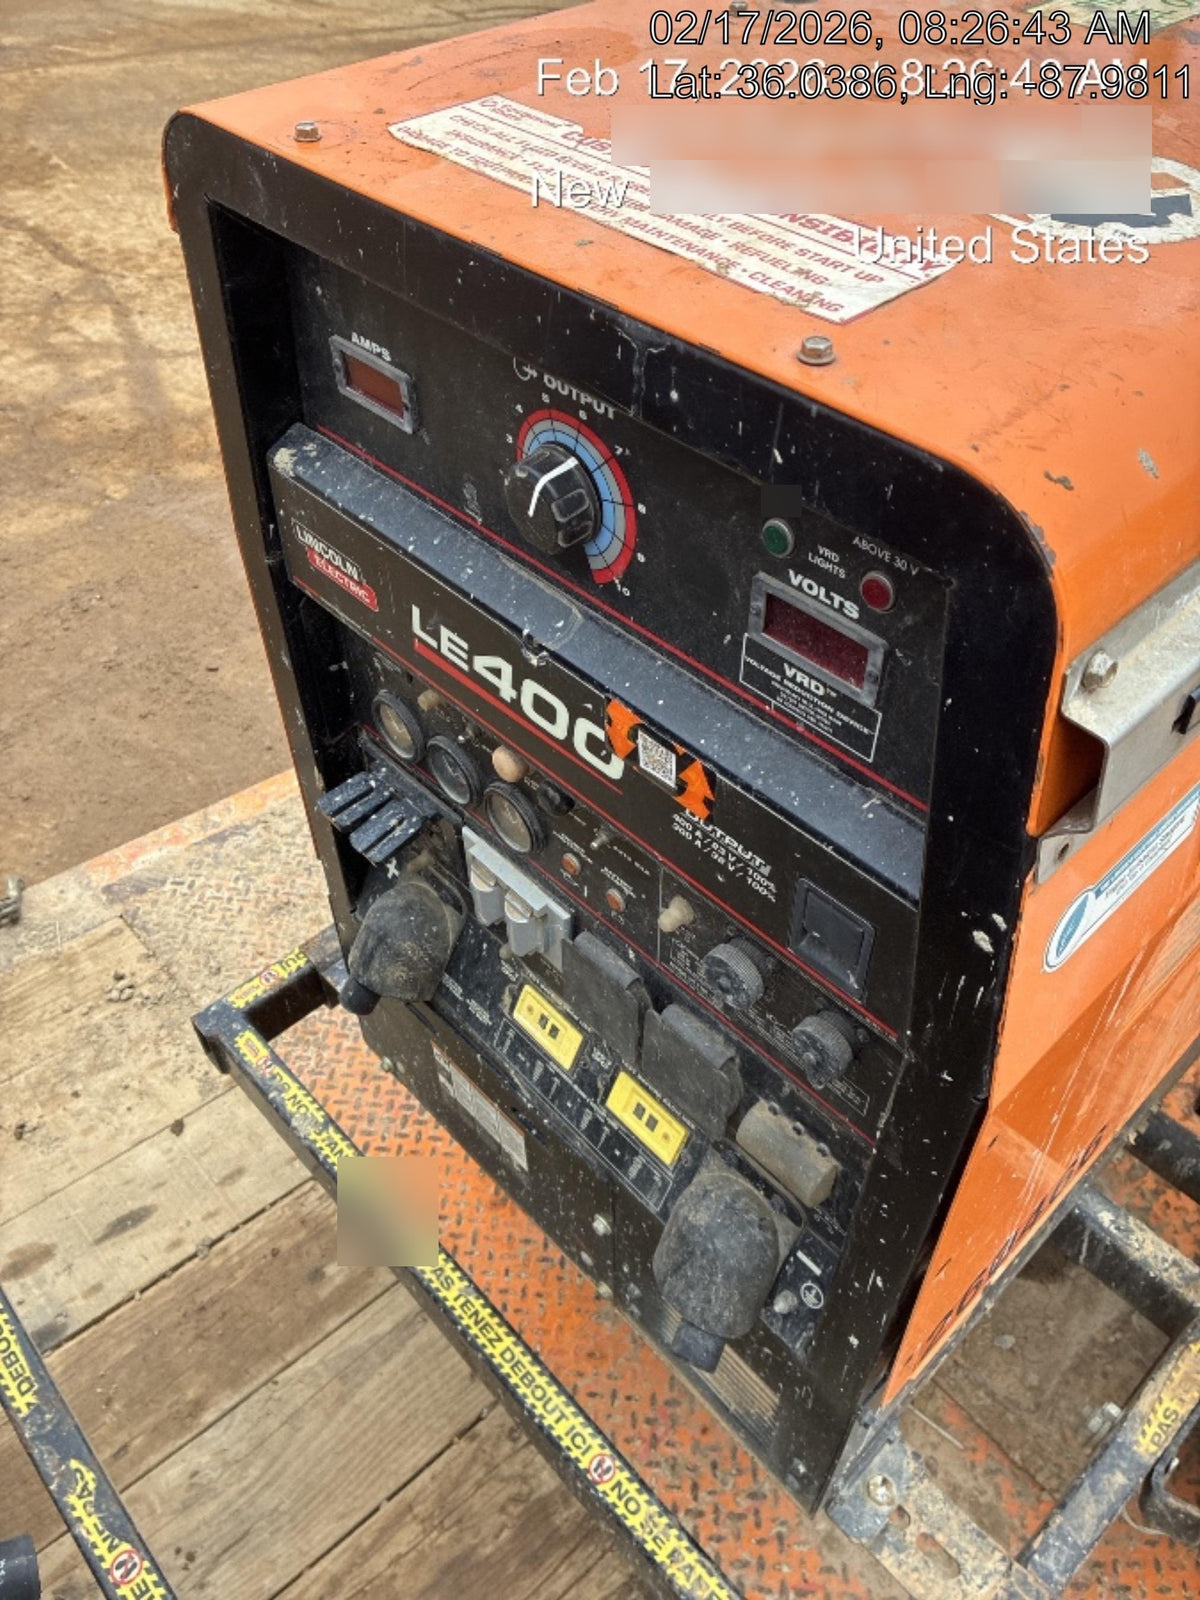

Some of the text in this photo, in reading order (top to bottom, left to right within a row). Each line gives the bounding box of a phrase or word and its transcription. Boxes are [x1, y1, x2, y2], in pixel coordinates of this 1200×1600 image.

[793, 238, 851, 275] START
[351, 331, 393, 362] AMPS
[542, 373, 619, 420] OUTPUT
[807, 551, 847, 580] LIGHTS
[817, 544, 841, 563] VRD
[853, 535, 920, 577] ABOVE 30 V
[787, 568, 861, 621] VOLTS
[411, 603, 626, 780] LE400
[0, 1321, 35, 1396] DEBO
[429, 1266, 592, 1457] AS TENEZ DEBOUT ICI
[609, 1478, 642, 1518] NO
